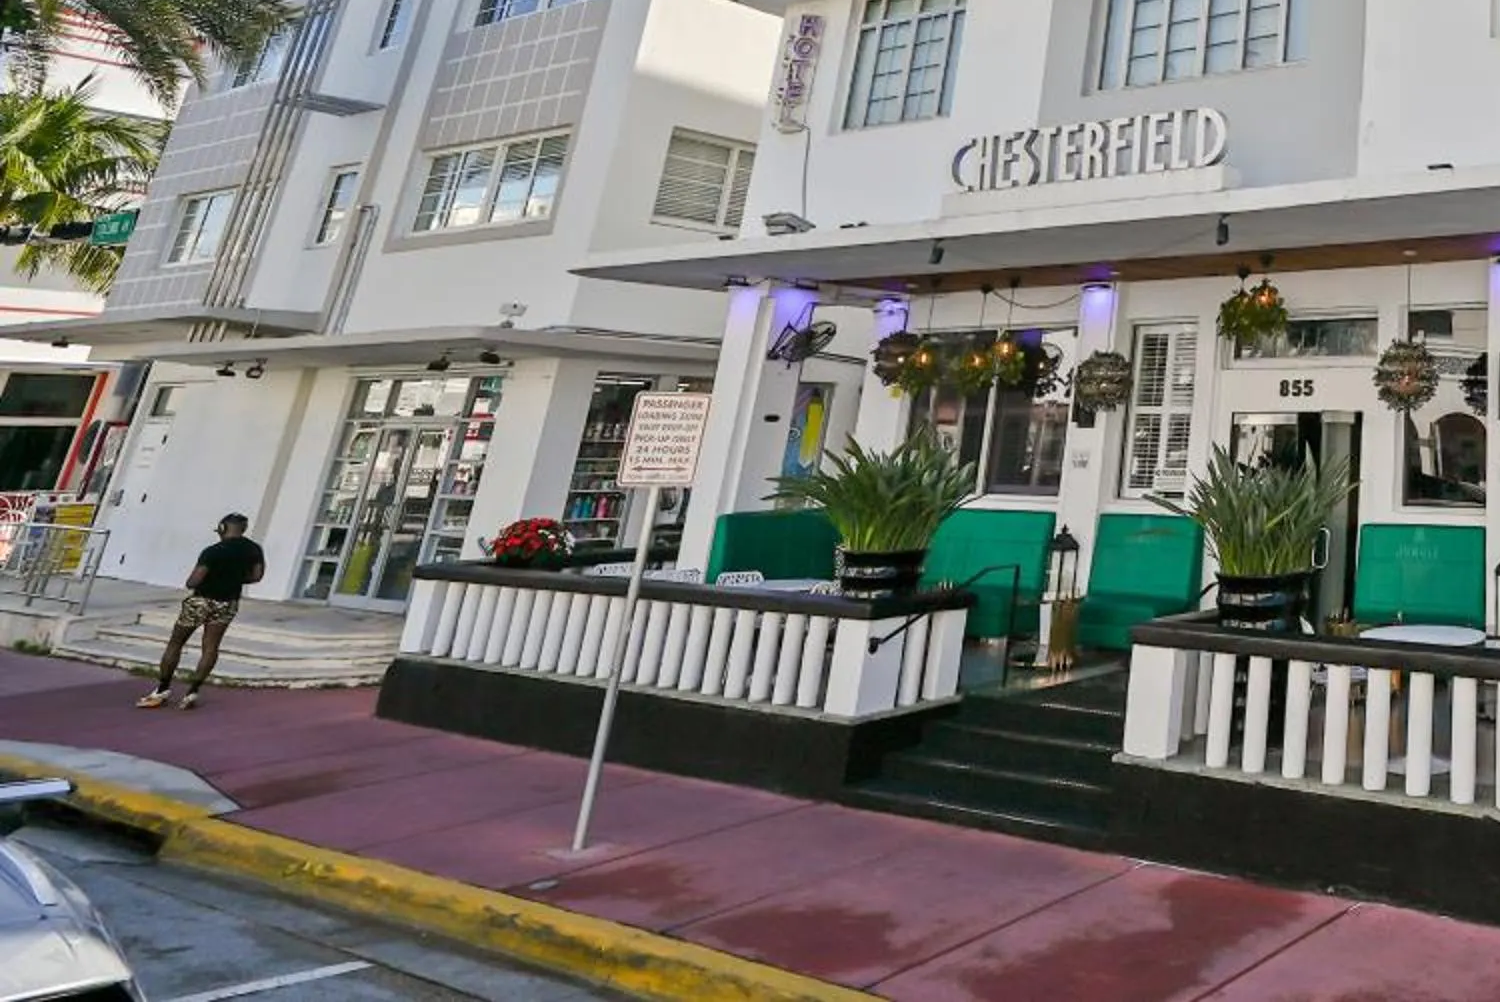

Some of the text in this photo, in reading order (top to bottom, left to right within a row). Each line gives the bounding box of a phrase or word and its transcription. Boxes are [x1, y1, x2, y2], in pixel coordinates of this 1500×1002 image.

[779, 14, 826, 126] HOTEL
[951, 107, 1228, 192] CHESTERFIELD
[1280, 379, 1314, 397] 855
[643, 398, 704, 409] PASSENGER
[638, 411, 704, 421] LOADING ZONE
[636, 445, 691, 454] 24 HOURS
[629, 456, 641, 464] 15
